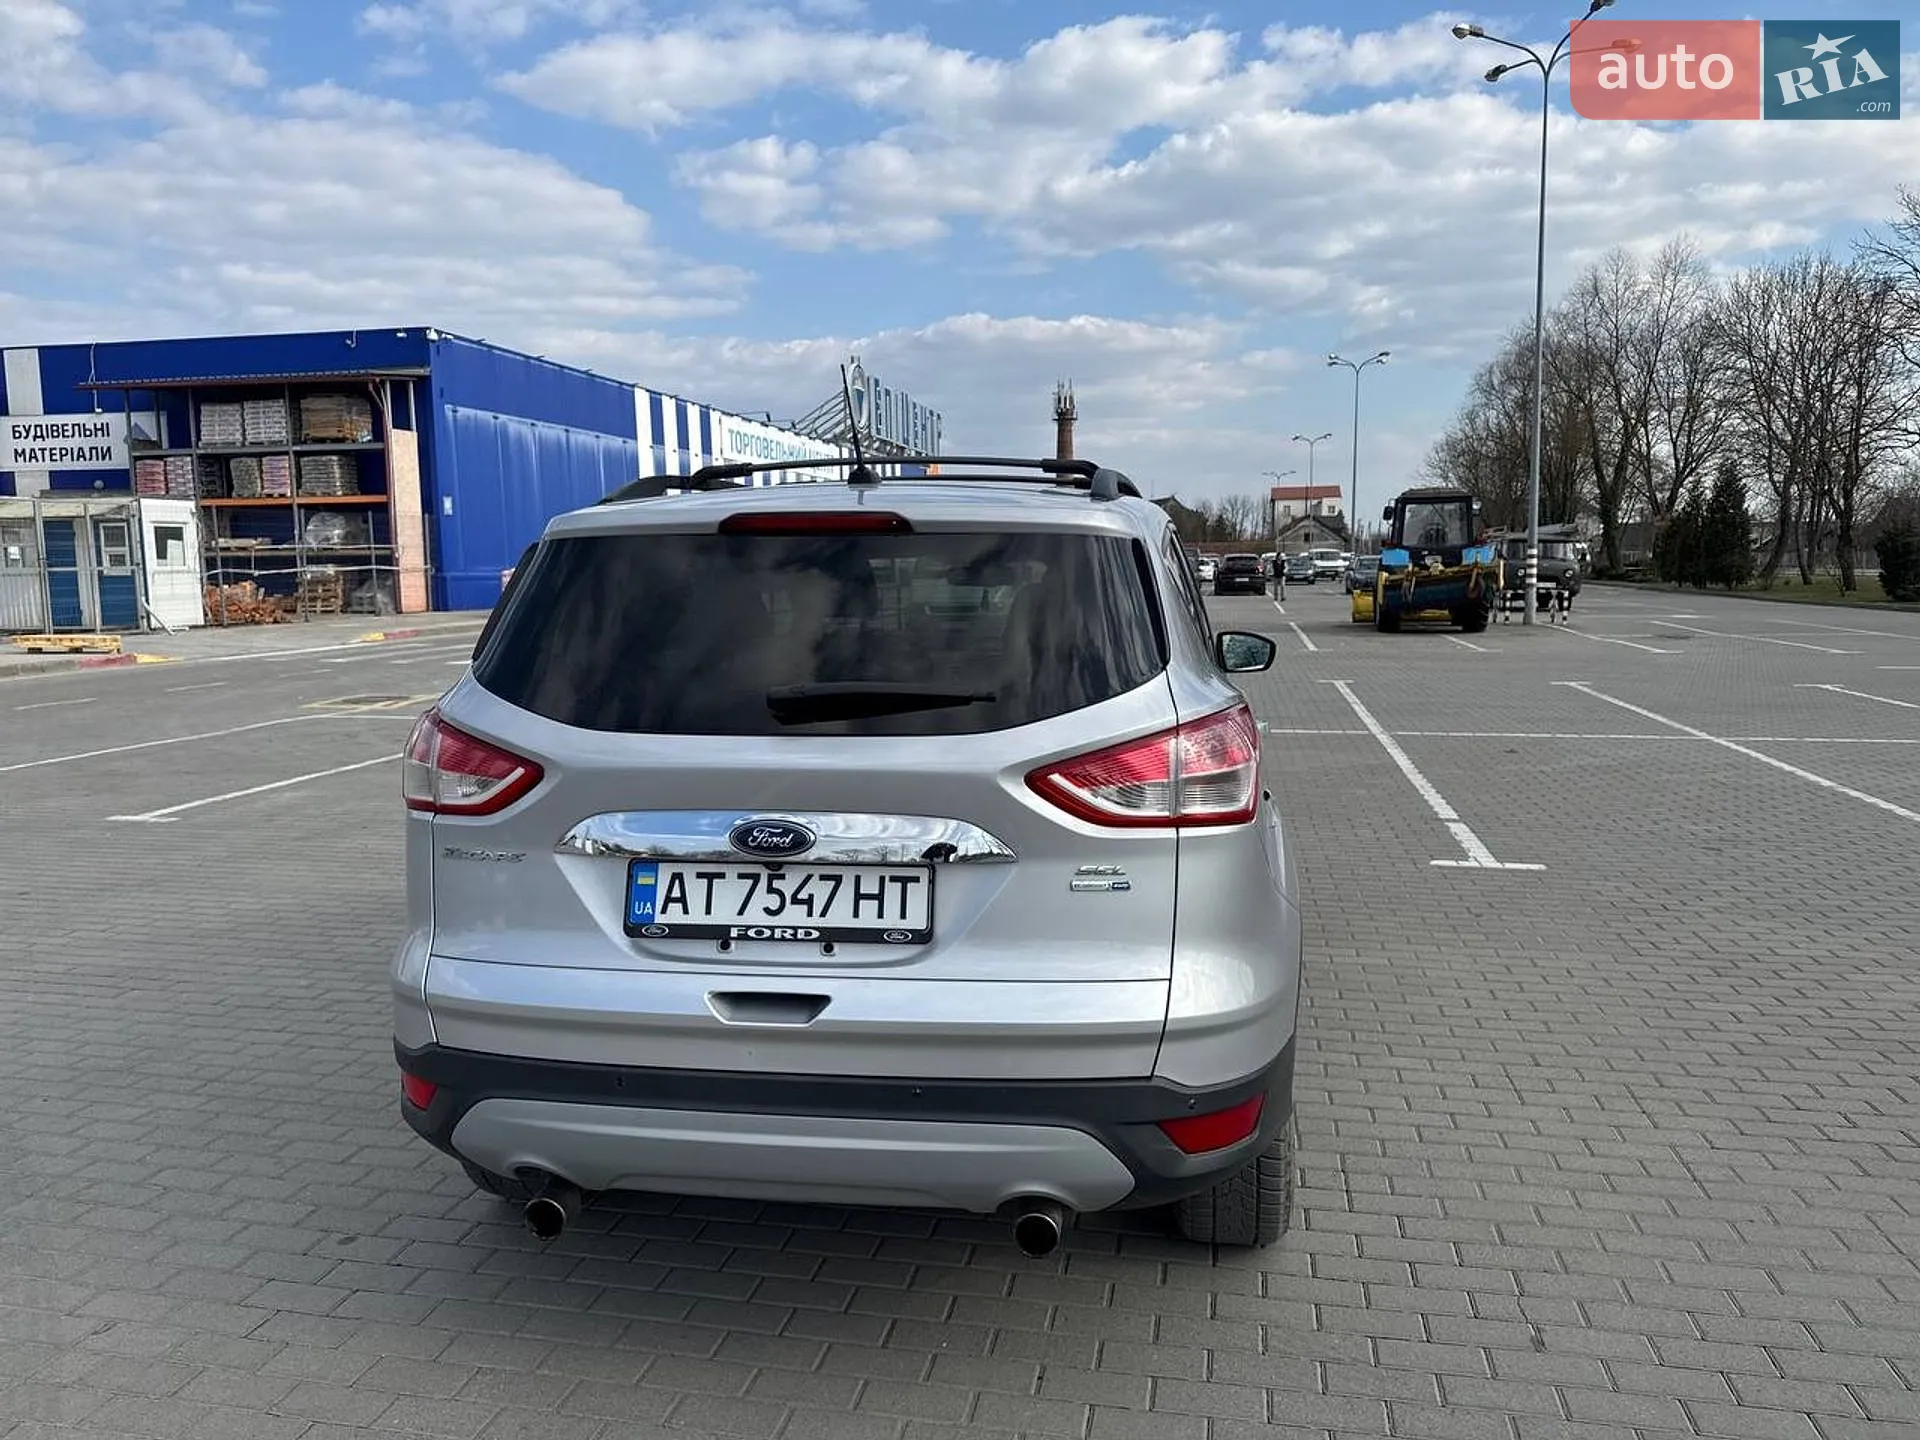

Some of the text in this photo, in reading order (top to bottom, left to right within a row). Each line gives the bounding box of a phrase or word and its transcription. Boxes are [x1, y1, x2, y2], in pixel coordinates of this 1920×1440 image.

[12, 422, 110, 441] БУДІВЕЛЬНІ
[14, 446, 112, 463] МАТЕРІАЛИ
[748, 827, 794, 847] Ford
[660, 871, 921, 920] AT 7547 HT
[634, 901, 654, 915] UA
[730, 926, 821, 940] FORD
